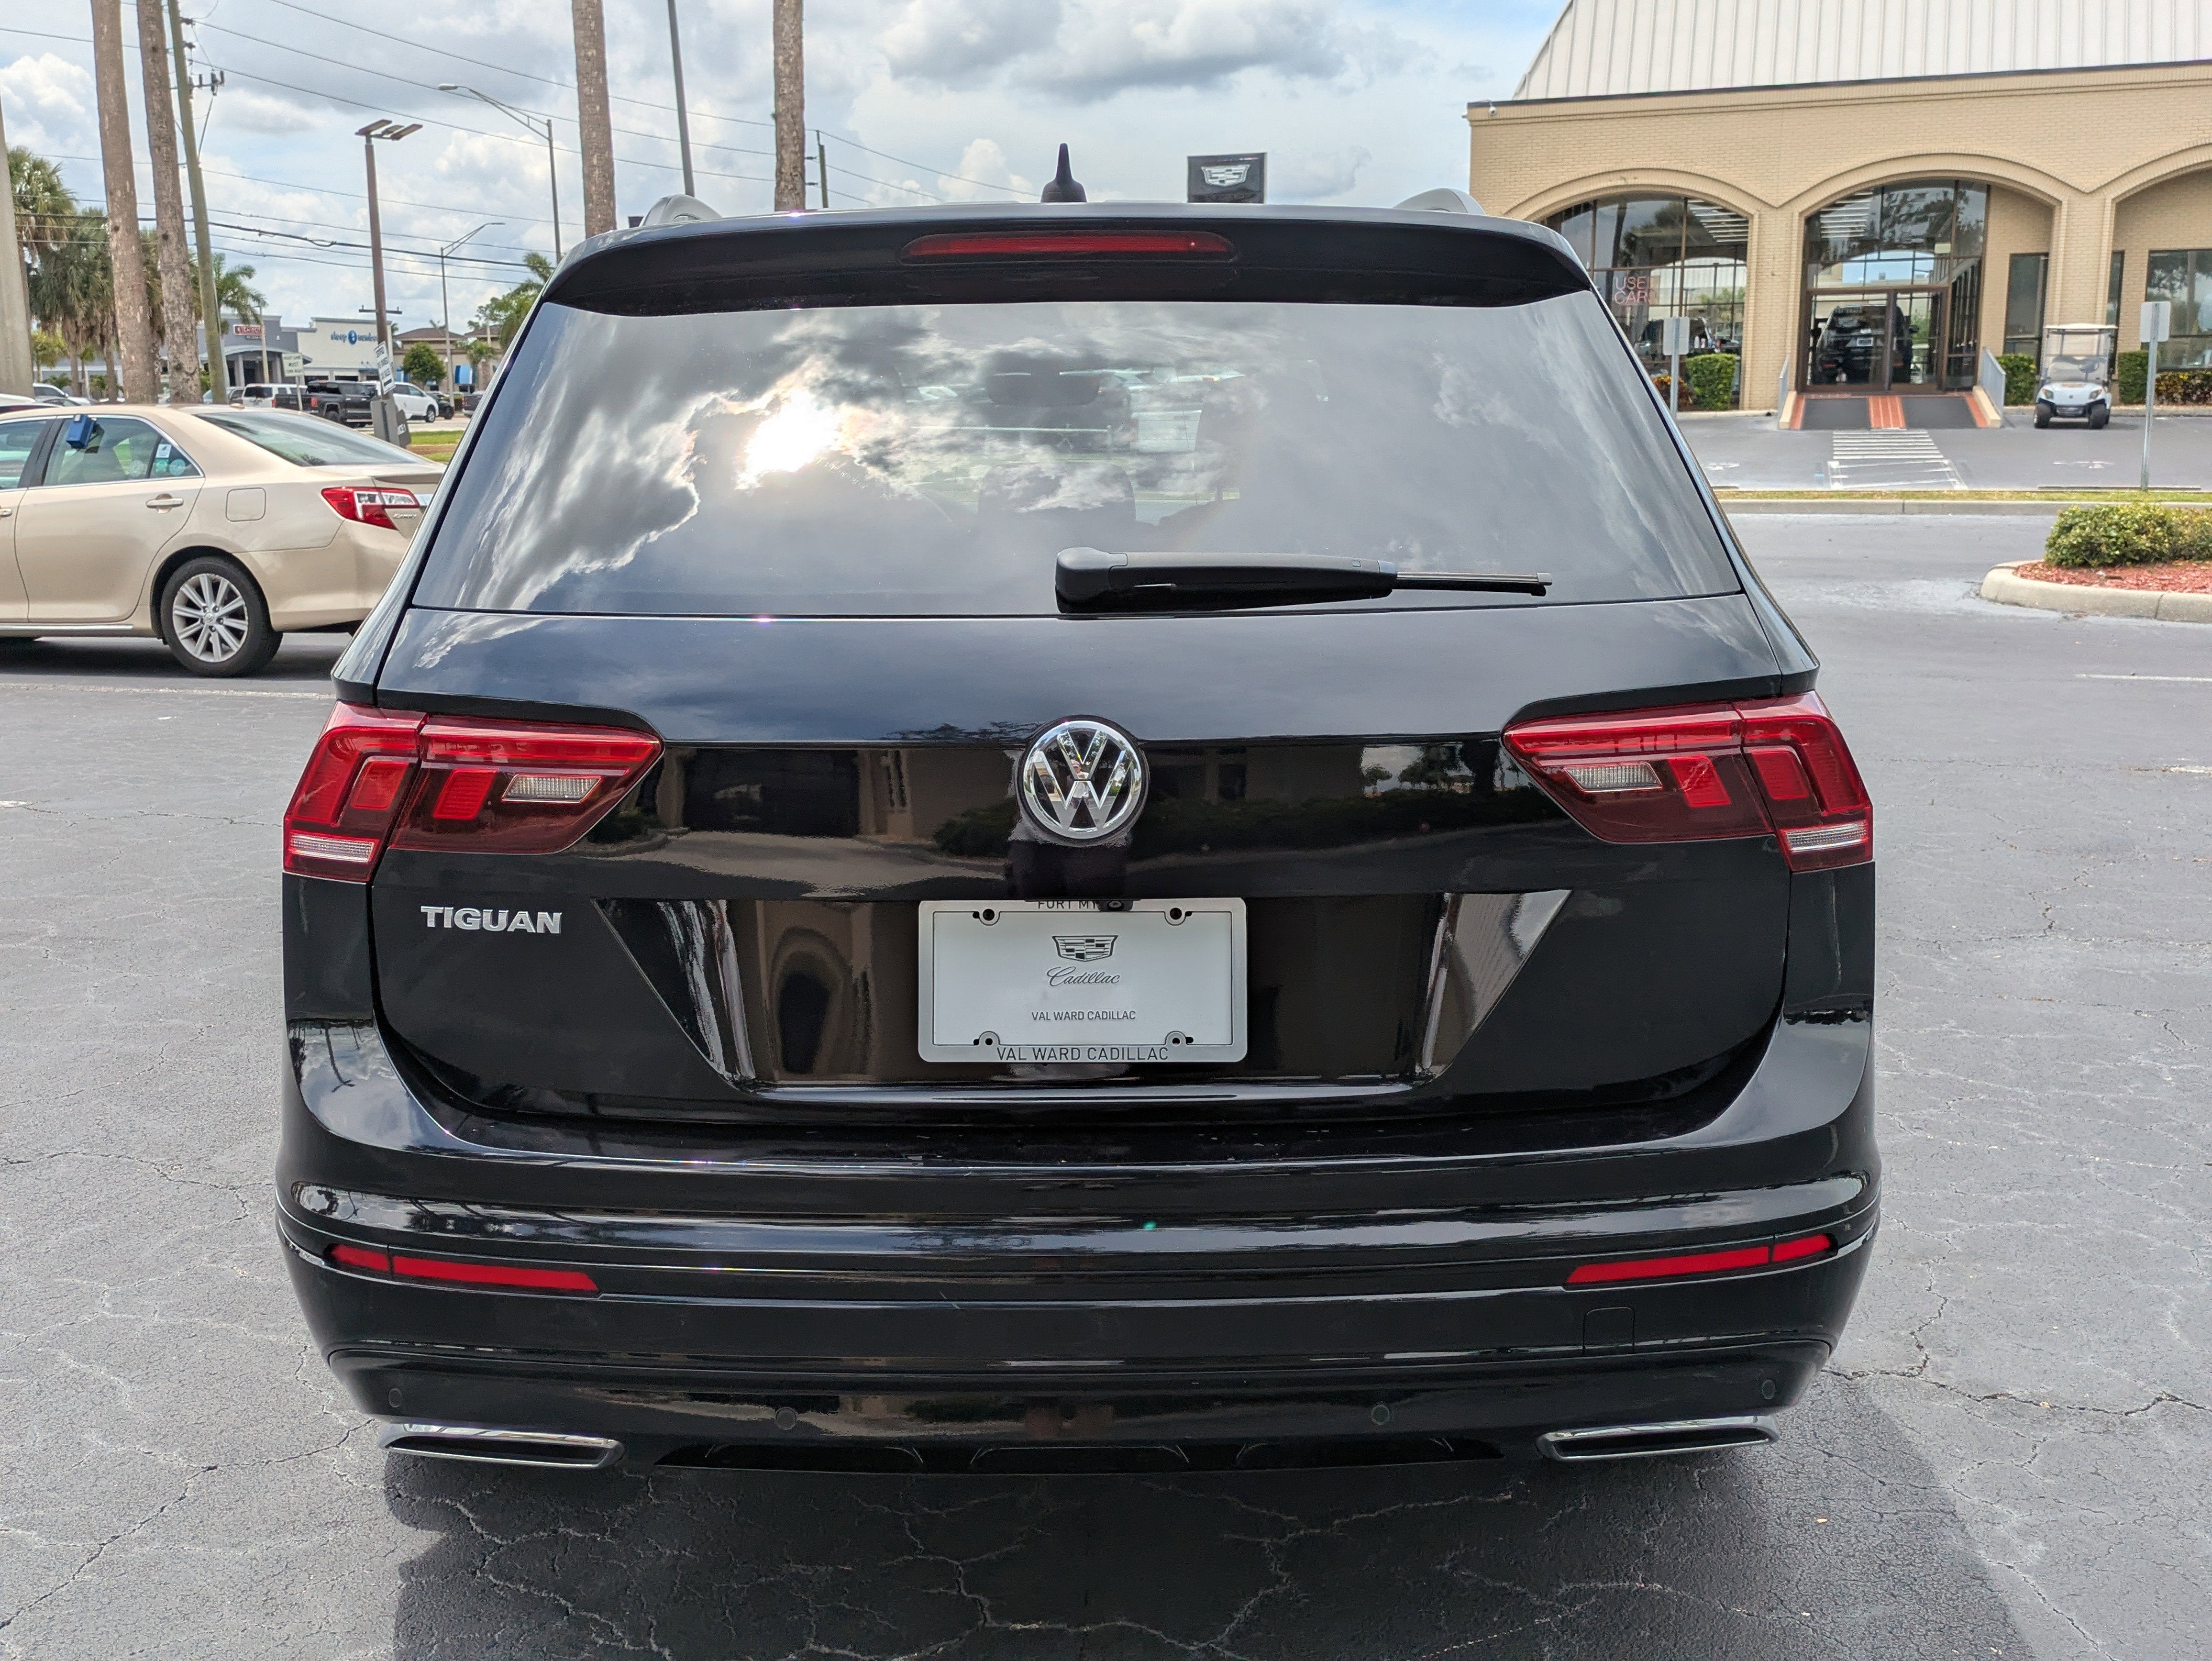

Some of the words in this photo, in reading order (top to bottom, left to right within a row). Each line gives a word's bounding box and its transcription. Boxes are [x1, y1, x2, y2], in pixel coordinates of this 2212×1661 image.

[1079, 900, 1100, 909] MY
[420, 906, 562, 933] TIGUAN
[1046, 966, 1120, 986] Cadillac
[1031, 1011, 1051, 1020] VAL
[1053, 1011, 1084, 1020] WARD
[1087, 1010, 1136, 1020] CADILLAC
[996, 1047, 1027, 1061] VAL
[1032, 1047, 1081, 1061] WARD
[1087, 1047, 1169, 1061] CADILLAC
